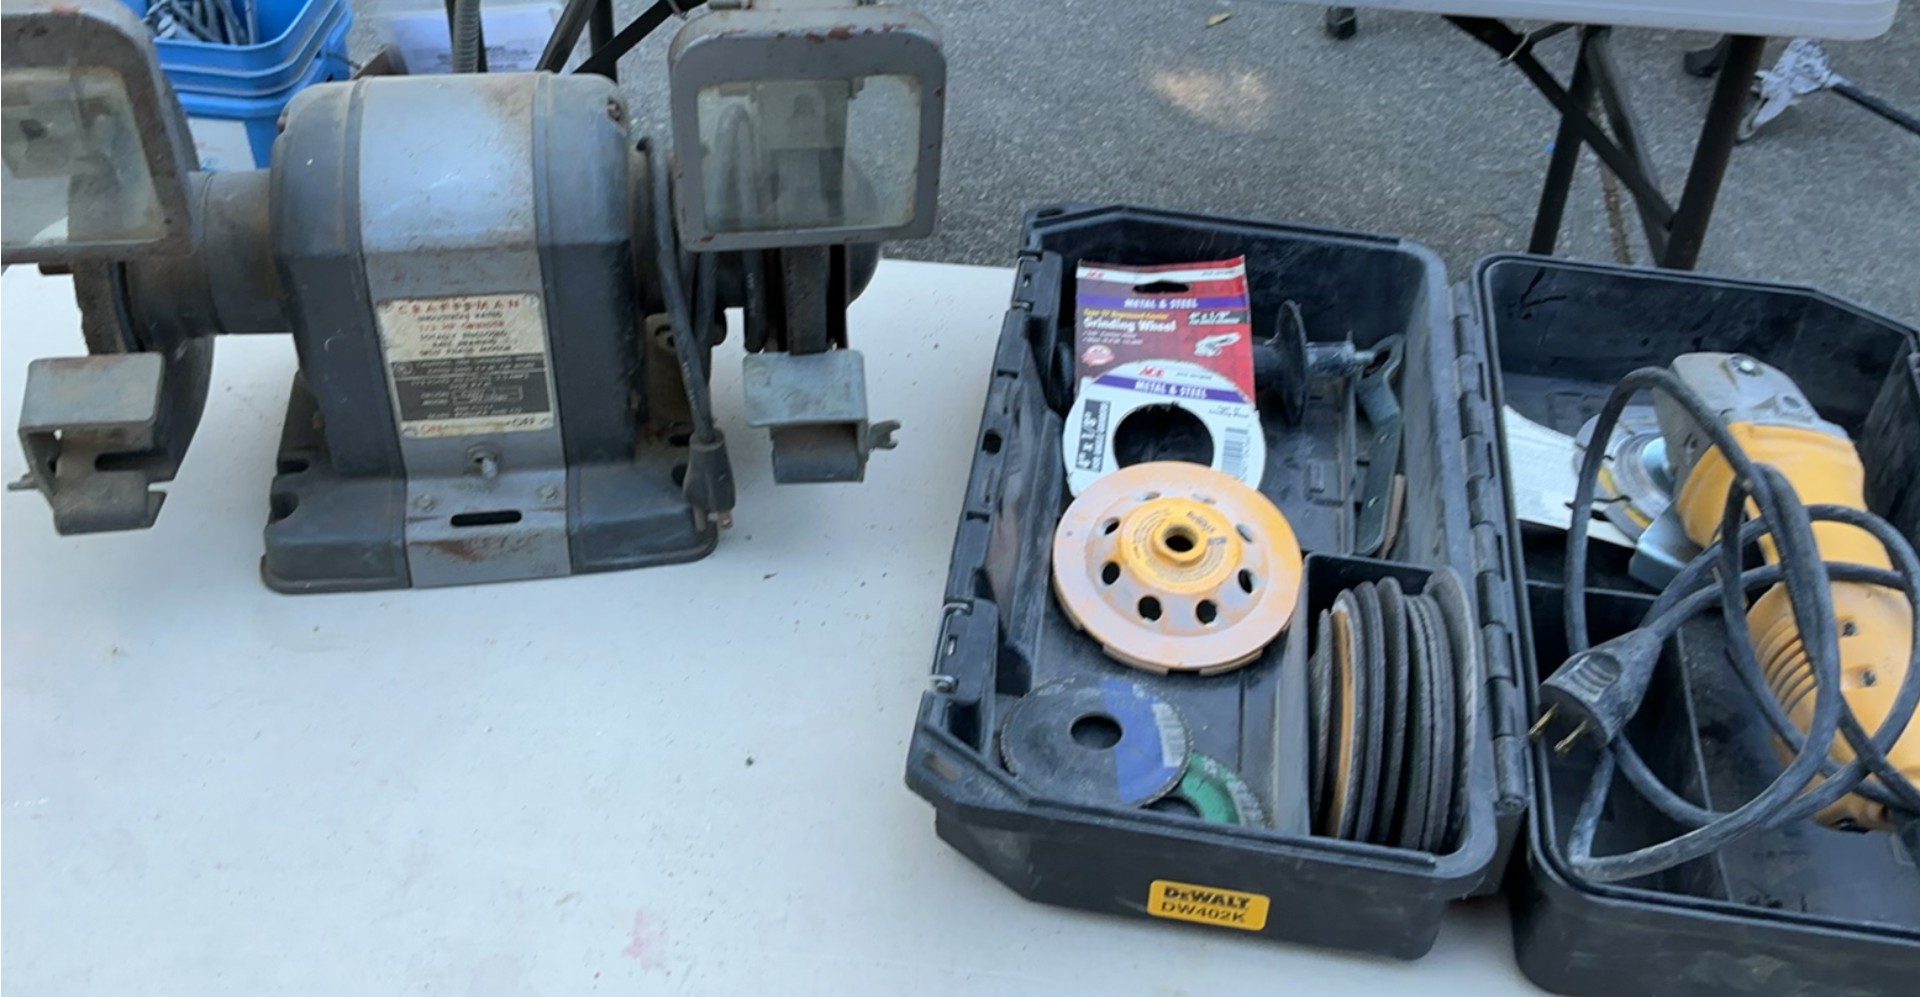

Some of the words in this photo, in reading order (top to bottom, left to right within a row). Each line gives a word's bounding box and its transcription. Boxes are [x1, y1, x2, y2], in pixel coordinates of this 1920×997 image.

[1124, 298, 1157, 308] METAL
[1159, 299, 1167, 308] &
[1169, 298, 1199, 308] STEEL
[1083, 316, 1136, 333] Grinding
[1137, 319, 1177, 332] Wheel
[1134, 380, 1167, 394] METAL
[1169, 384, 1178, 395] &
[1180, 385, 1208, 399] STEEL
[1160, 901, 1246, 923] DW402K
